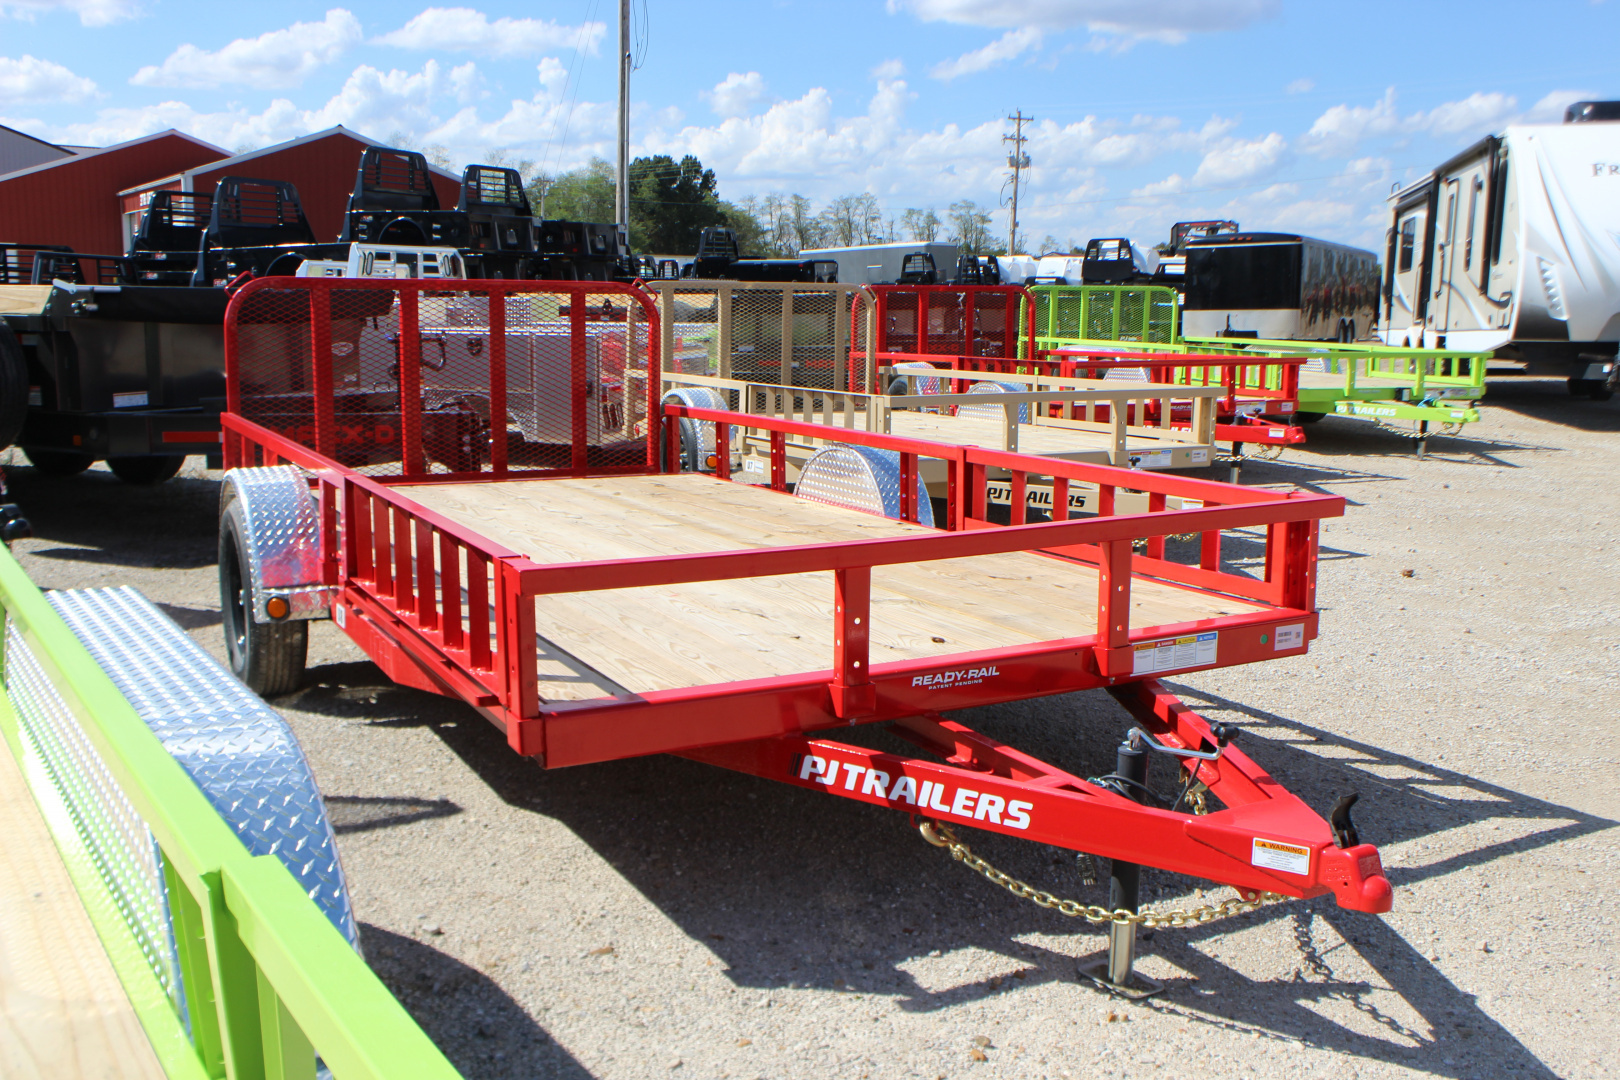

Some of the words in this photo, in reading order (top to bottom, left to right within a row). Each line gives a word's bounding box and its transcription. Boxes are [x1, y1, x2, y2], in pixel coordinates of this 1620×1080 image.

[1004, 488, 1087, 508] TAILS
[912, 665, 1000, 687] READY-RAIL
[954, 678, 983, 687] PENDING
[799, 754, 840, 786] PJ
[842, 762, 1034, 830] TRAILERS
[1269, 843, 1303, 855] WARNING
